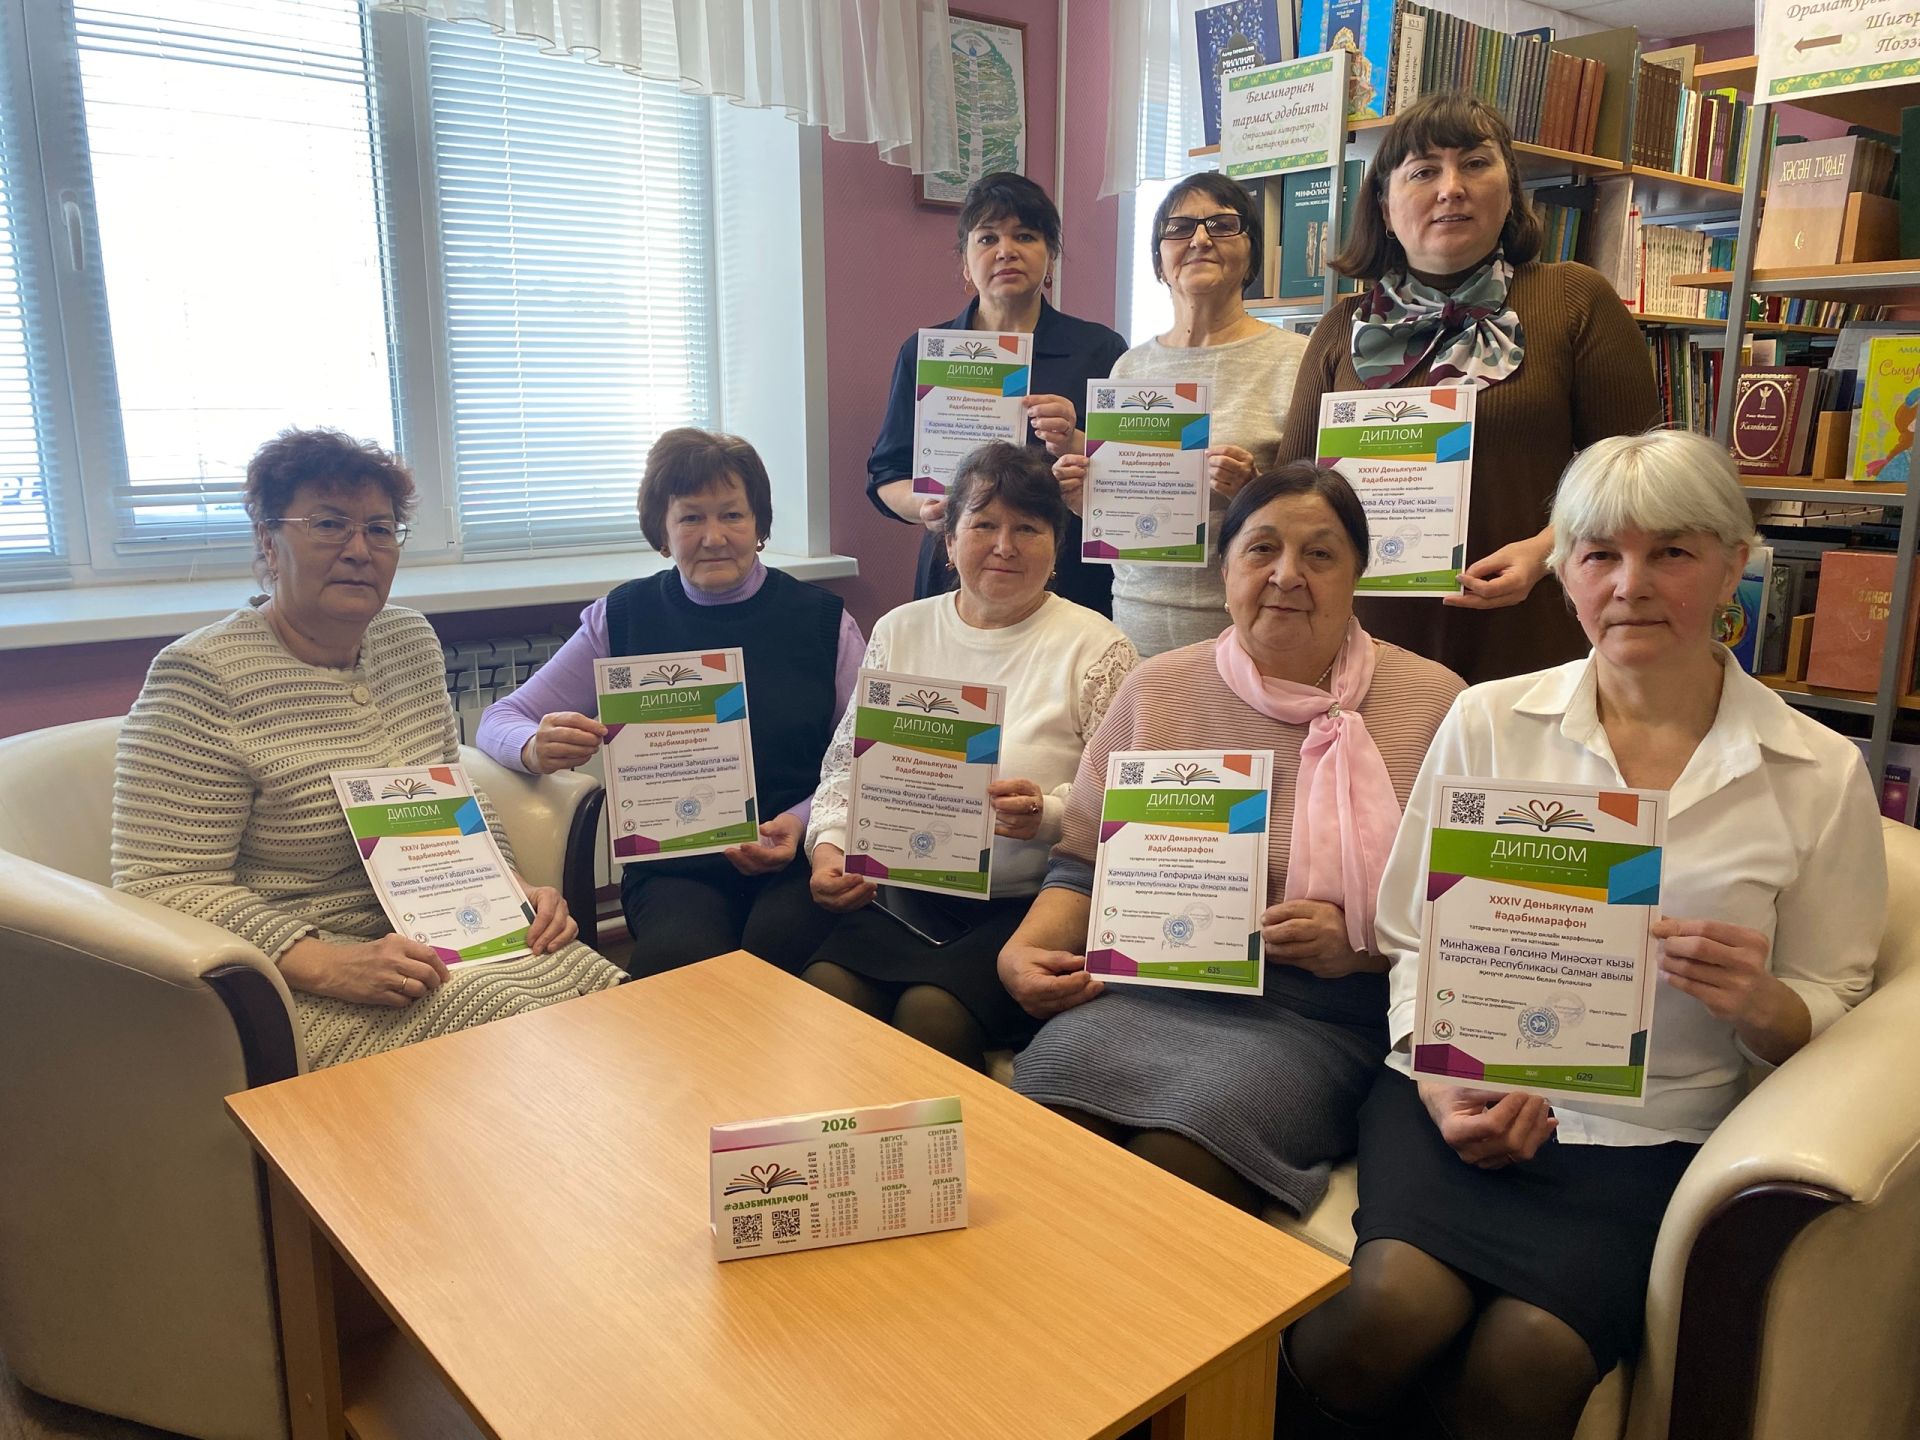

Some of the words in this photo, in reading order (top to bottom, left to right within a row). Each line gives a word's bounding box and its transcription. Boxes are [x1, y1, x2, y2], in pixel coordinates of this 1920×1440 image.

[1787, 0, 1890, 20] Драматур
[1875, 36, 1920, 53] Поэз
[1246, 82, 1314, 104] Белемнәрнең
[1275, 102, 1329, 120] әдәбияты
[1278, 122, 1316, 134] литература
[1780, 158, 1812, 182] ХӘСӘН
[1814, 154, 1846, 178] ТУФАН
[946, 365, 994, 376] ДИПЛОМ
[1119, 418, 1170, 428] ДИПЛОМ
[1360, 428, 1422, 442] ДИПЛОМ
[640, 690, 700, 708] ДИПЛОМ
[894, 716, 954, 735] ДИПЛОМ
[1146, 794, 1215, 808] ДИПЛОМ
[386, 804, 440, 822] ДИПЛОМ
[1491, 839, 1587, 863] ДИПЛОМ
[1136, 880, 1176, 888] Республикасы
[1489, 895, 1522, 906] XXXIV
[1523, 898, 1594, 914] Дөньякүләм
[1495, 910, 1587, 928] #әдәбимарафон
[1504, 946, 1548, 959] Гөлсинә
[1551, 952, 1603, 966] Минәсхәт
[1606, 959, 1634, 969] кызы
[1208, 966, 1220, 974] 635
[1440, 951, 1487, 966] Татарстан
[1490, 958, 1558, 974] Республикасы
[1561, 966, 1598, 978] Салман
[1600, 972, 1634, 982] авылы
[1576, 1072, 1593, 1082] 629
[821, 1117, 857, 1132] 2026
[928, 1128, 956, 1136] СЕНТЯБРЬ
[880, 1134, 903, 1142] АВГУСТ
[932, 1177, 960, 1186] ДЕКАБРЬ
[724, 1193, 808, 1211] #ӘДӘБИМАРАФОН
[828, 1190, 856, 1198] ОКТЯБРЬ
